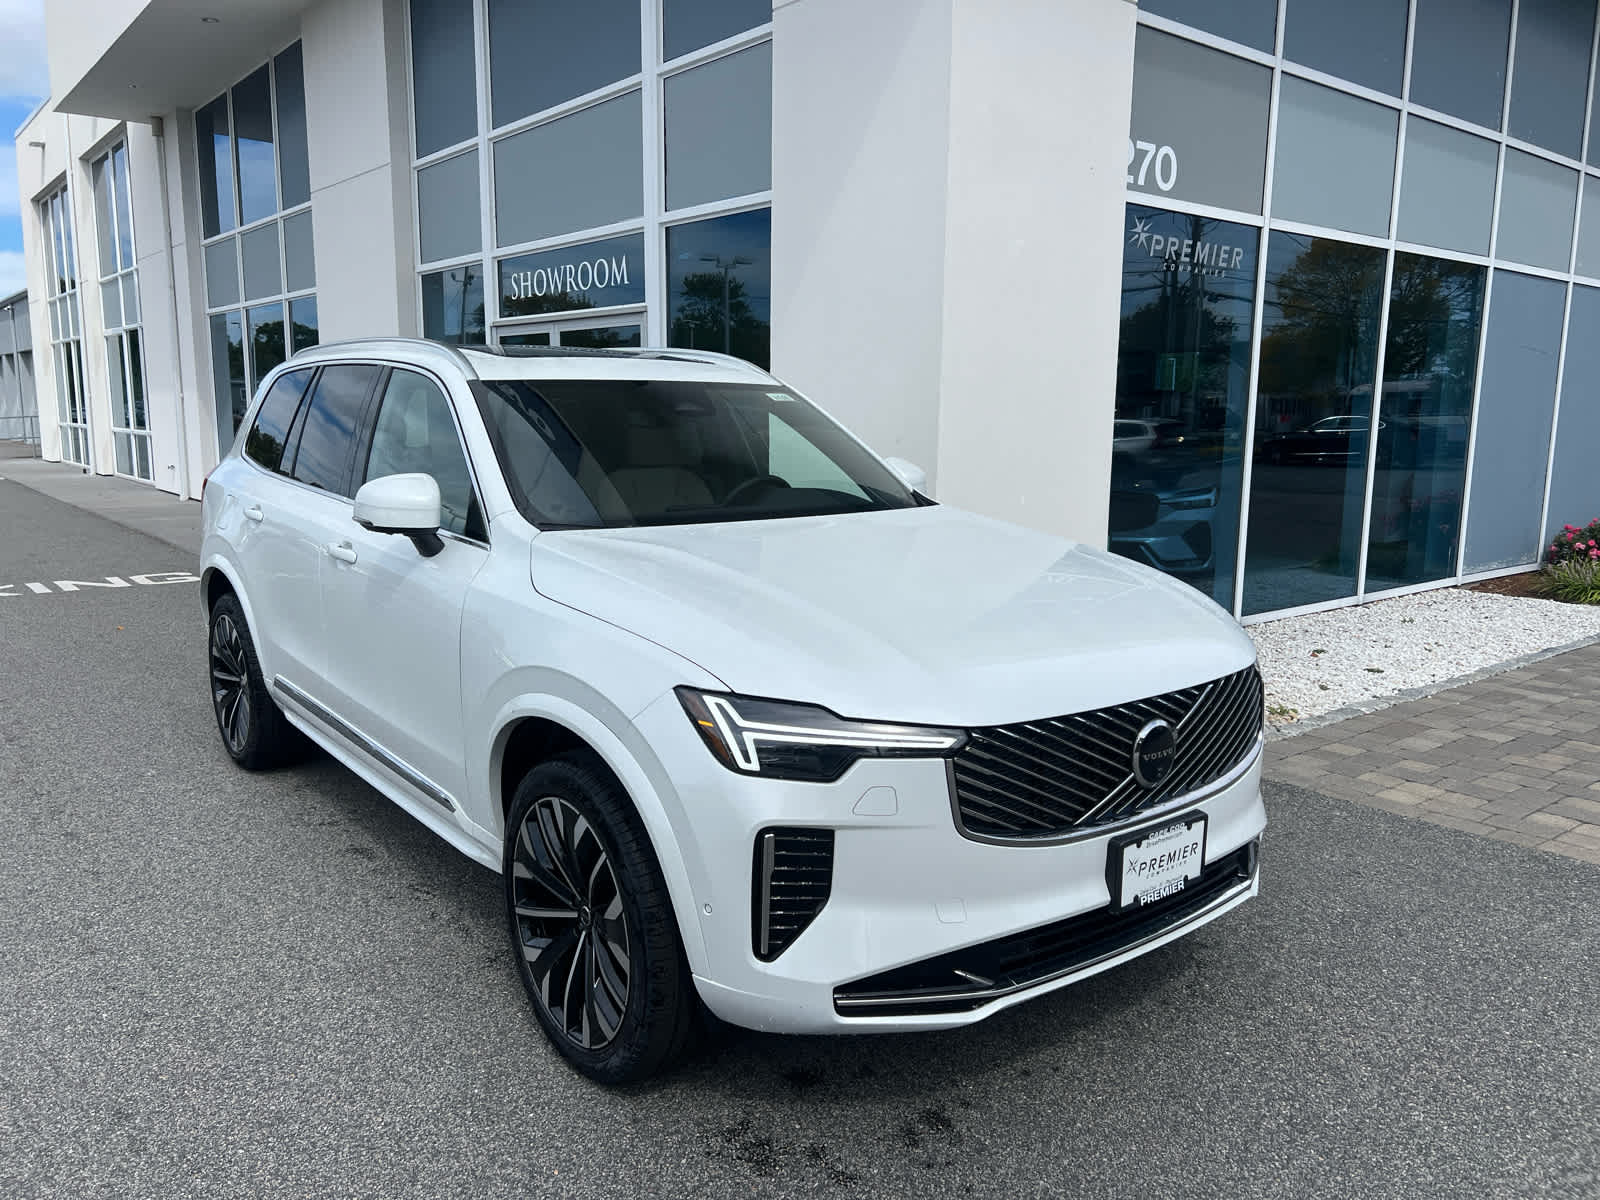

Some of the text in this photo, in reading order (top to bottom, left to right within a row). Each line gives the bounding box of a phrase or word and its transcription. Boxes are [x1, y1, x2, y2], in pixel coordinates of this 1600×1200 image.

[1150, 234, 1243, 269] PREMIER
[511, 253, 630, 300] SHOWROOM
[1163, 263, 1225, 278] COMPANIES
[1143, 747, 1174, 761] VOLVO
[1138, 842, 1199, 877] PREMIER
[1140, 880, 1185, 907] PREMIER
